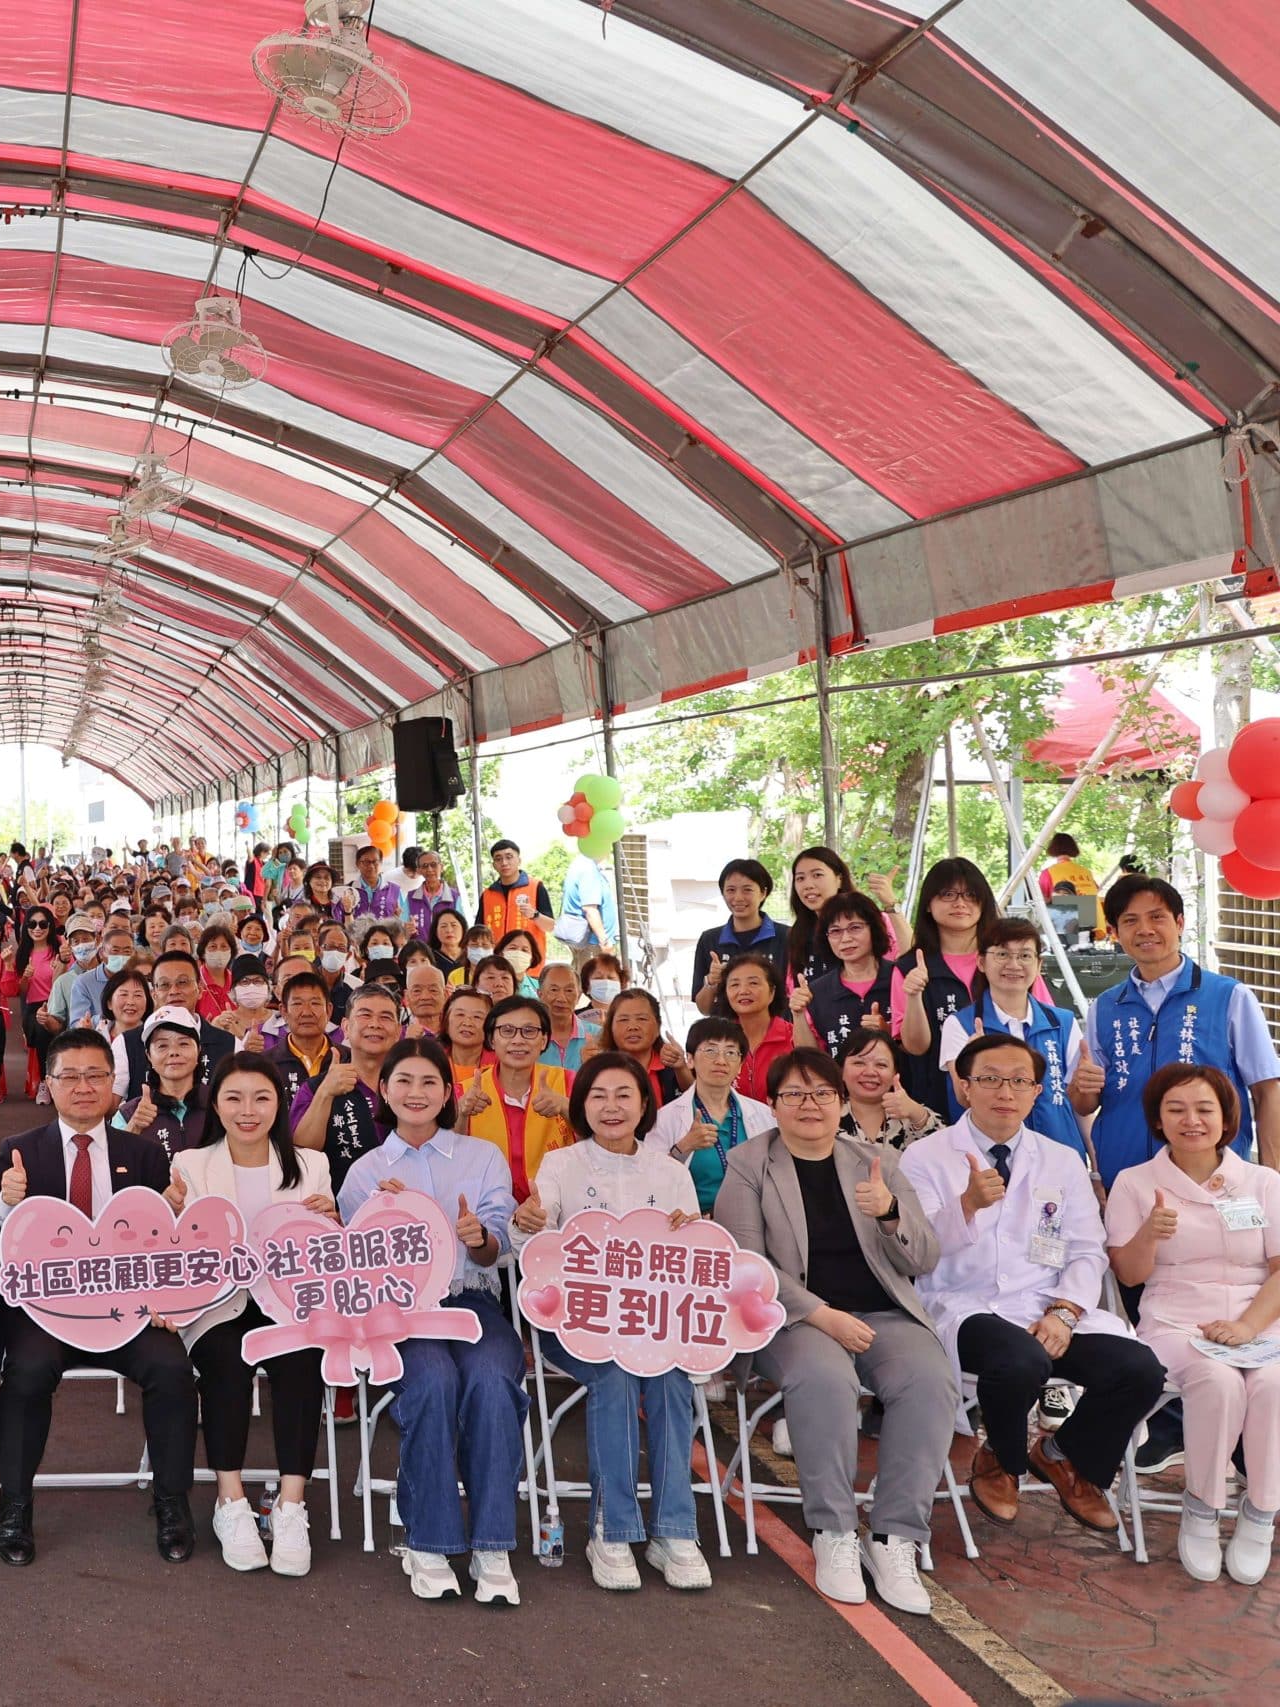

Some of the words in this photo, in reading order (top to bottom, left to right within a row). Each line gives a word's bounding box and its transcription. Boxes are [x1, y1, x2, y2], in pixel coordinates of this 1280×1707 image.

[838, 1014, 852, 1044] 社會
[1127, 1016, 1144, 1057] 社會處
[1044, 1039, 1066, 1106] 雲林縣政府
[343, 1099, 363, 1149] 公正里長
[4, 1246, 258, 1300] 社區照顧更安心
[266, 1224, 430, 1279] 社福服務
[563, 1234, 732, 1290] 全齡照顧
[294, 1274, 415, 1320] 更貼心
[563, 1280, 728, 1346] 更到位
